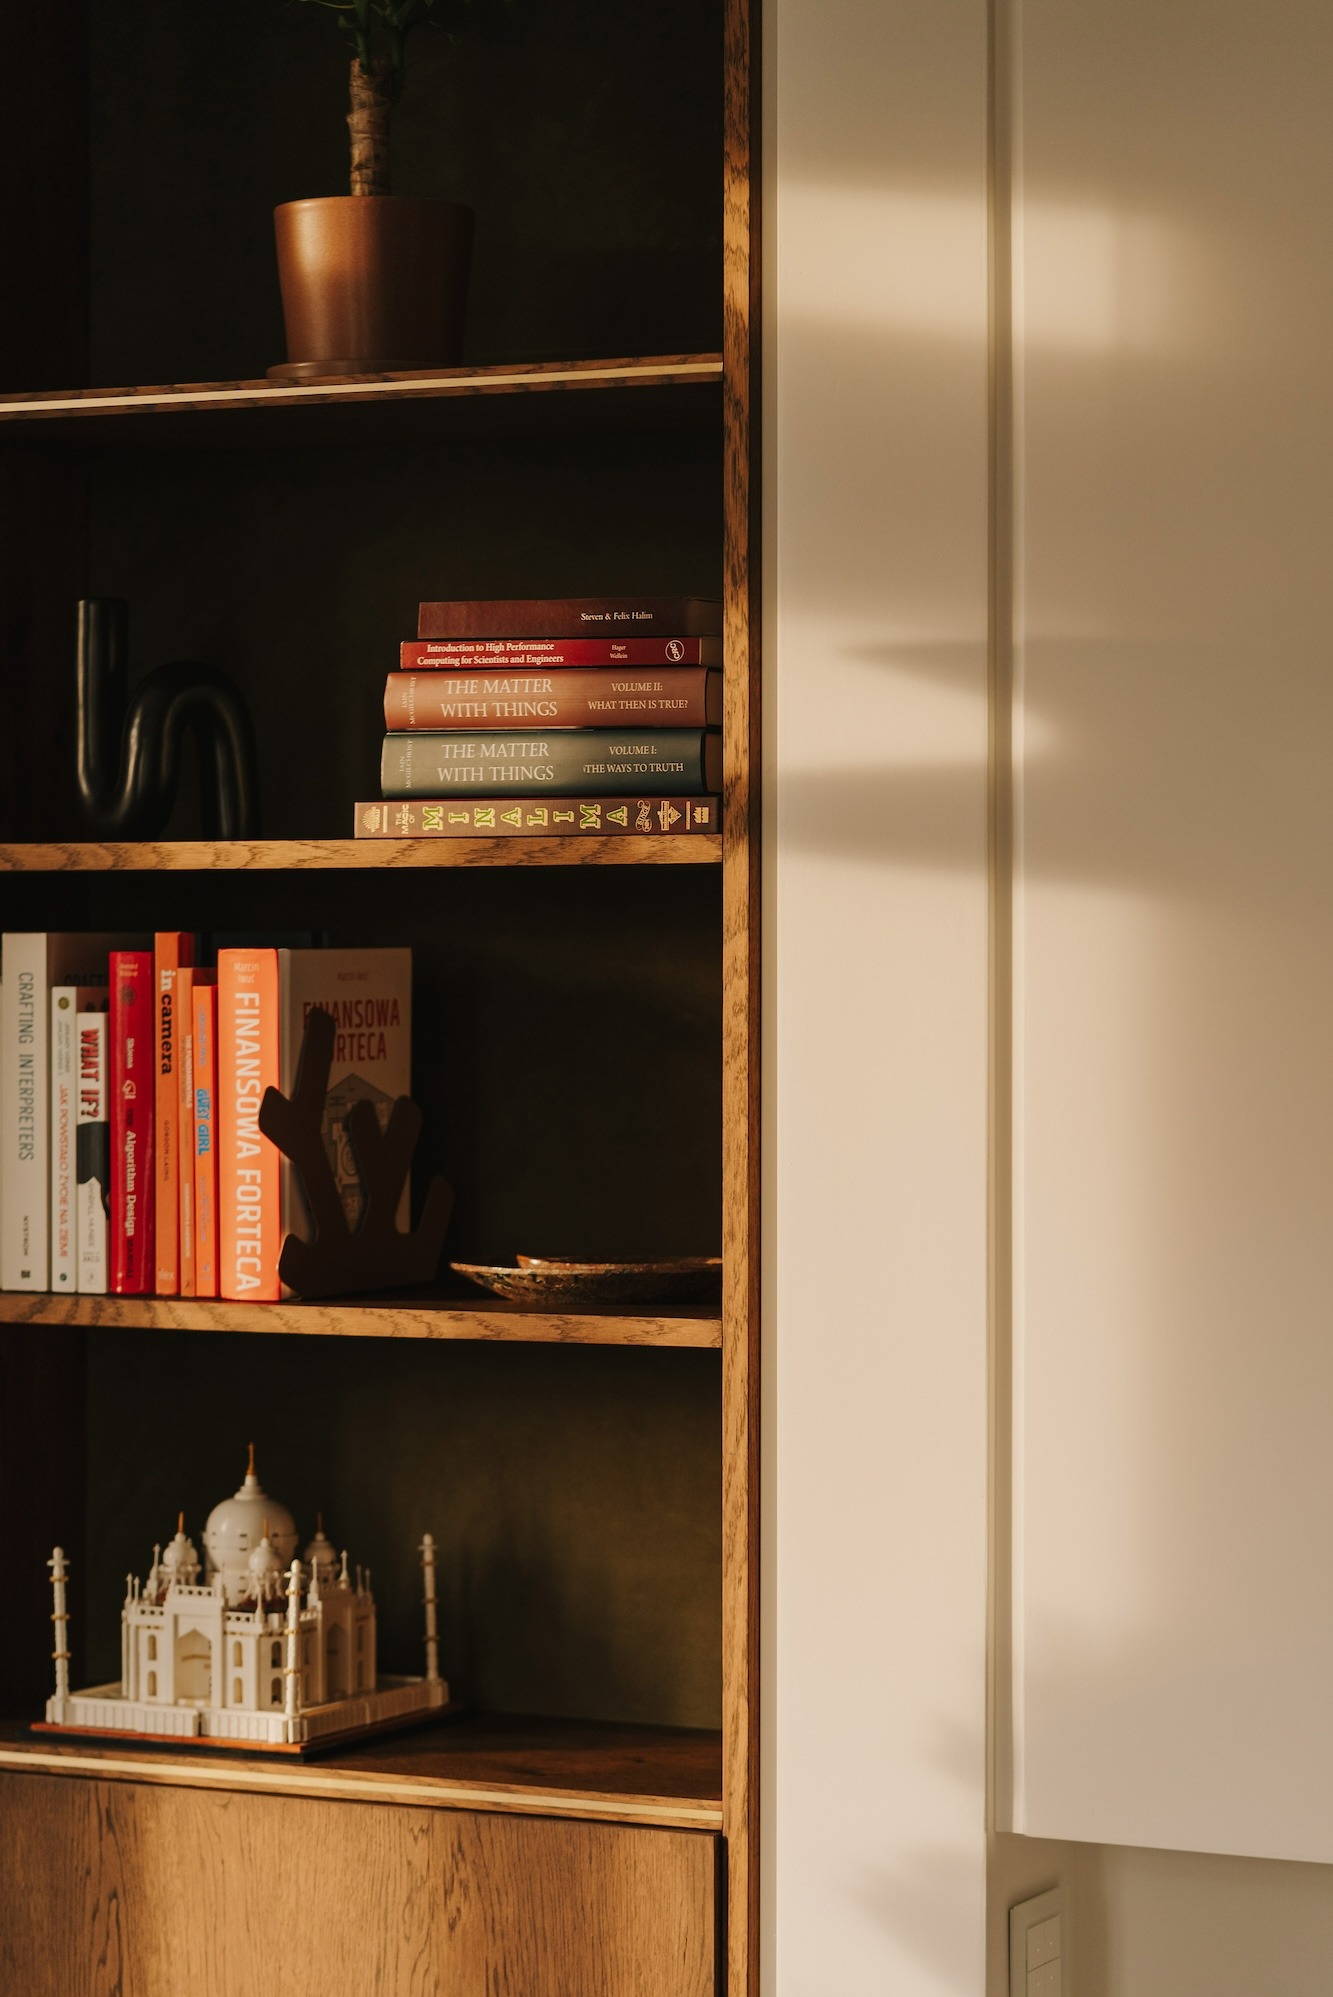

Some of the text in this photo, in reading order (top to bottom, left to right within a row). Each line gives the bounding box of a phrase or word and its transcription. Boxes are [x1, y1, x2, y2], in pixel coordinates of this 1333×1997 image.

[581, 610, 653, 621] Steven & Felix Halim
[427, 641, 555, 653] Introduction to High Performance
[611, 644, 627, 652] Hager
[668, 641, 681, 661] CRC
[417, 654, 565, 667] Computing for Scientists and Engineers
[445, 678, 554, 695] THE MATTER
[611, 682, 663, 691] VOLUME II:
[440, 701, 558, 718] WITH THINGS
[588, 699, 689, 710] WHAT THEN IS TRUE?
[441, 742, 549, 759] THE MATTER
[609, 745, 658, 755] VOLUME I:
[437, 765, 554, 782] WITH THINGS
[585, 762, 685, 773] THE WAYS TO TRUTH
[401, 803, 409, 834] MAGIC
[161, 969, 176, 1075] in camera
[302, 998, 401, 1029] FANSOWA
[331, 1031, 389, 1063] RTECA
[18, 972, 35, 1161] CRAFTING INTERPRETERS
[80, 1028, 101, 1118] WHAT IF?
[196, 1088, 211, 1157] GUTSY GIRL
[235, 991, 262, 1292] FINANSOWA FORTECA
[125, 1130, 137, 1193] Algorithm
[60, 1208, 68, 1224] NA
[124, 1194, 137, 1237] Design
